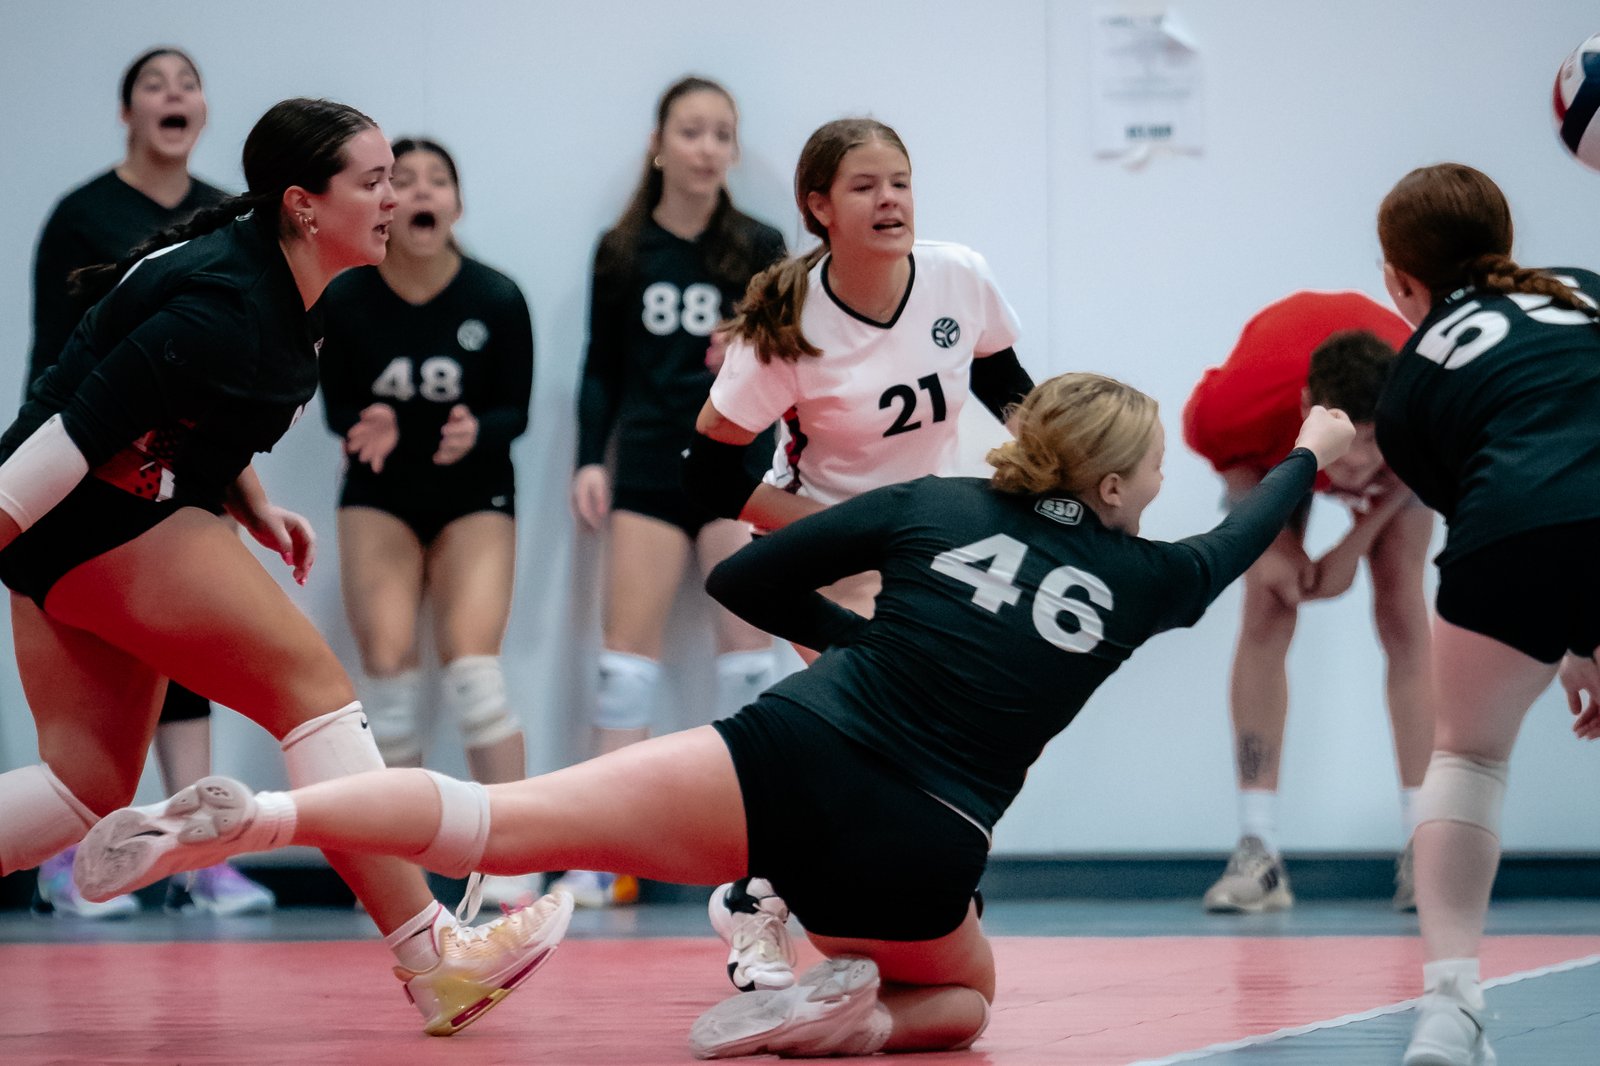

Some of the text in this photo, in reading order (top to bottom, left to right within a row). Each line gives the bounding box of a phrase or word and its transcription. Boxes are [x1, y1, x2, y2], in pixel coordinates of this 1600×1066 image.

[642, 282, 722, 336] 88
[372, 356, 462, 402] 48
[878, 373, 947, 438] 21
[930, 533, 1114, 653] 46
